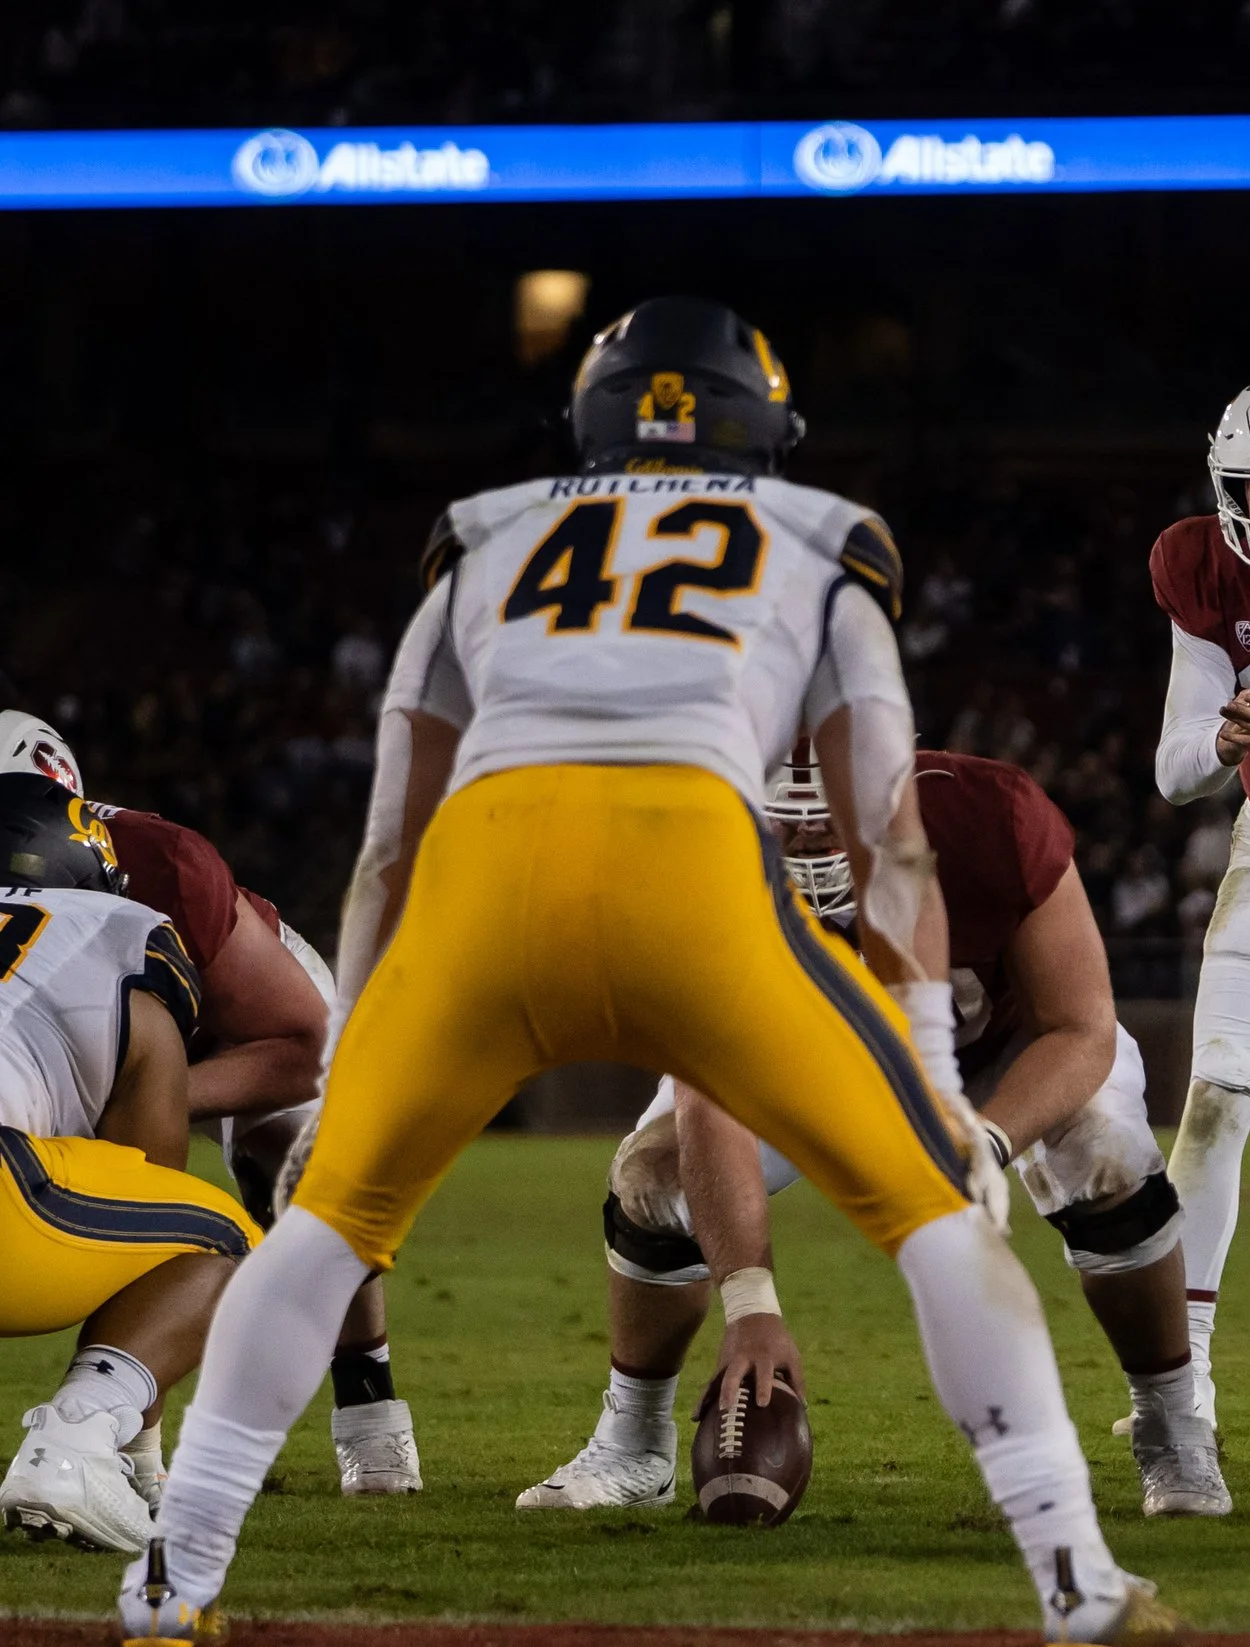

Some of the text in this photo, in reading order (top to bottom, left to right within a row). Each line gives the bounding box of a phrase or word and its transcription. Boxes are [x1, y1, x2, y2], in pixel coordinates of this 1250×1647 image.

[316, 141, 490, 191] Allstate
[879, 134, 1056, 184] Allstate
[499, 496, 771, 653] 42
